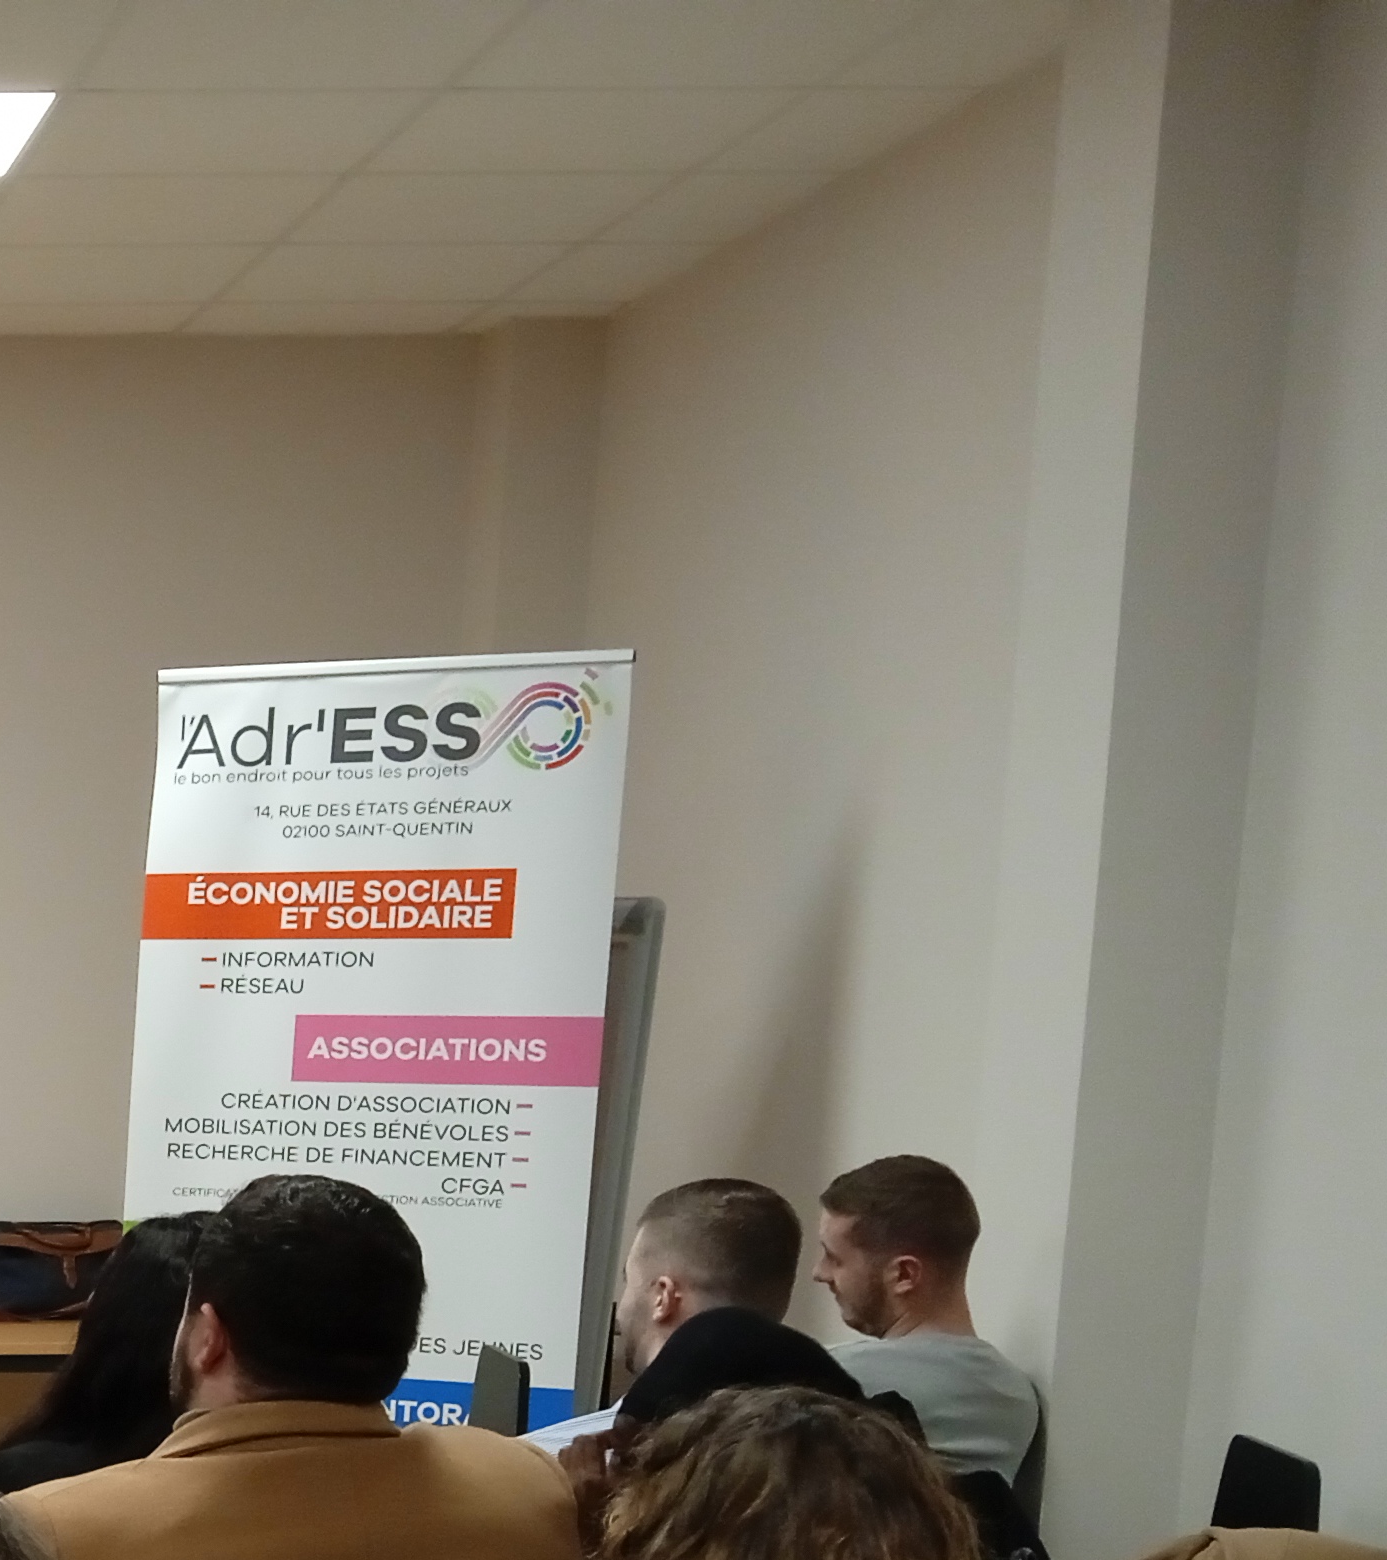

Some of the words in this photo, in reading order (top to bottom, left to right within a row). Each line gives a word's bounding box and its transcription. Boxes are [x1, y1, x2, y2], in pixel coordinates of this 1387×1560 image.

[174, 773, 186, 785] le
[191, 772, 221, 784] bon
[227, 770, 287, 783] endroit
[292, 770, 331, 783] pour
[337, 767, 373, 780] tous
[379, 766, 401, 778] les
[407, 764, 468, 779] projets
[254, 804, 274, 820] 14,
[278, 802, 312, 818] RUE
[317, 802, 352, 817] DES
[356, 798, 408, 816] ÉTATS
[414, 798, 513, 815] GÉNÉRAUX
[282, 823, 331, 839] 02100
[335, 820, 474, 838] SAINT-QUENTIN
[187, 875, 355, 905] ÉCONOMIE
[362, 877, 503, 904] SOCIALE
[280, 906, 319, 930] ET
[325, 905, 493, 930] SOLIDAIRE
[222, 950, 375, 969] INFORMATION
[220, 974, 304, 995] RÉSEAU
[307, 1037, 548, 1062] ASSOCIATIONS
[220, 1089, 330, 1113] CRÉATION
[337, 1094, 511, 1115] D'ASSOCIATION
[165, 1118, 317, 1138] MOBILISATION
[323, 1120, 366, 1139] DES
[372, 1120, 509, 1143] BÉNÉVOLES
[167, 1143, 300, 1164] RECHERCHE
[306, 1146, 335, 1164] DE
[342, 1147, 507, 1169] FINANCEMENT
[441, 1177, 505, 1196] CFGA
[415, 1337, 446, 1354] ES
